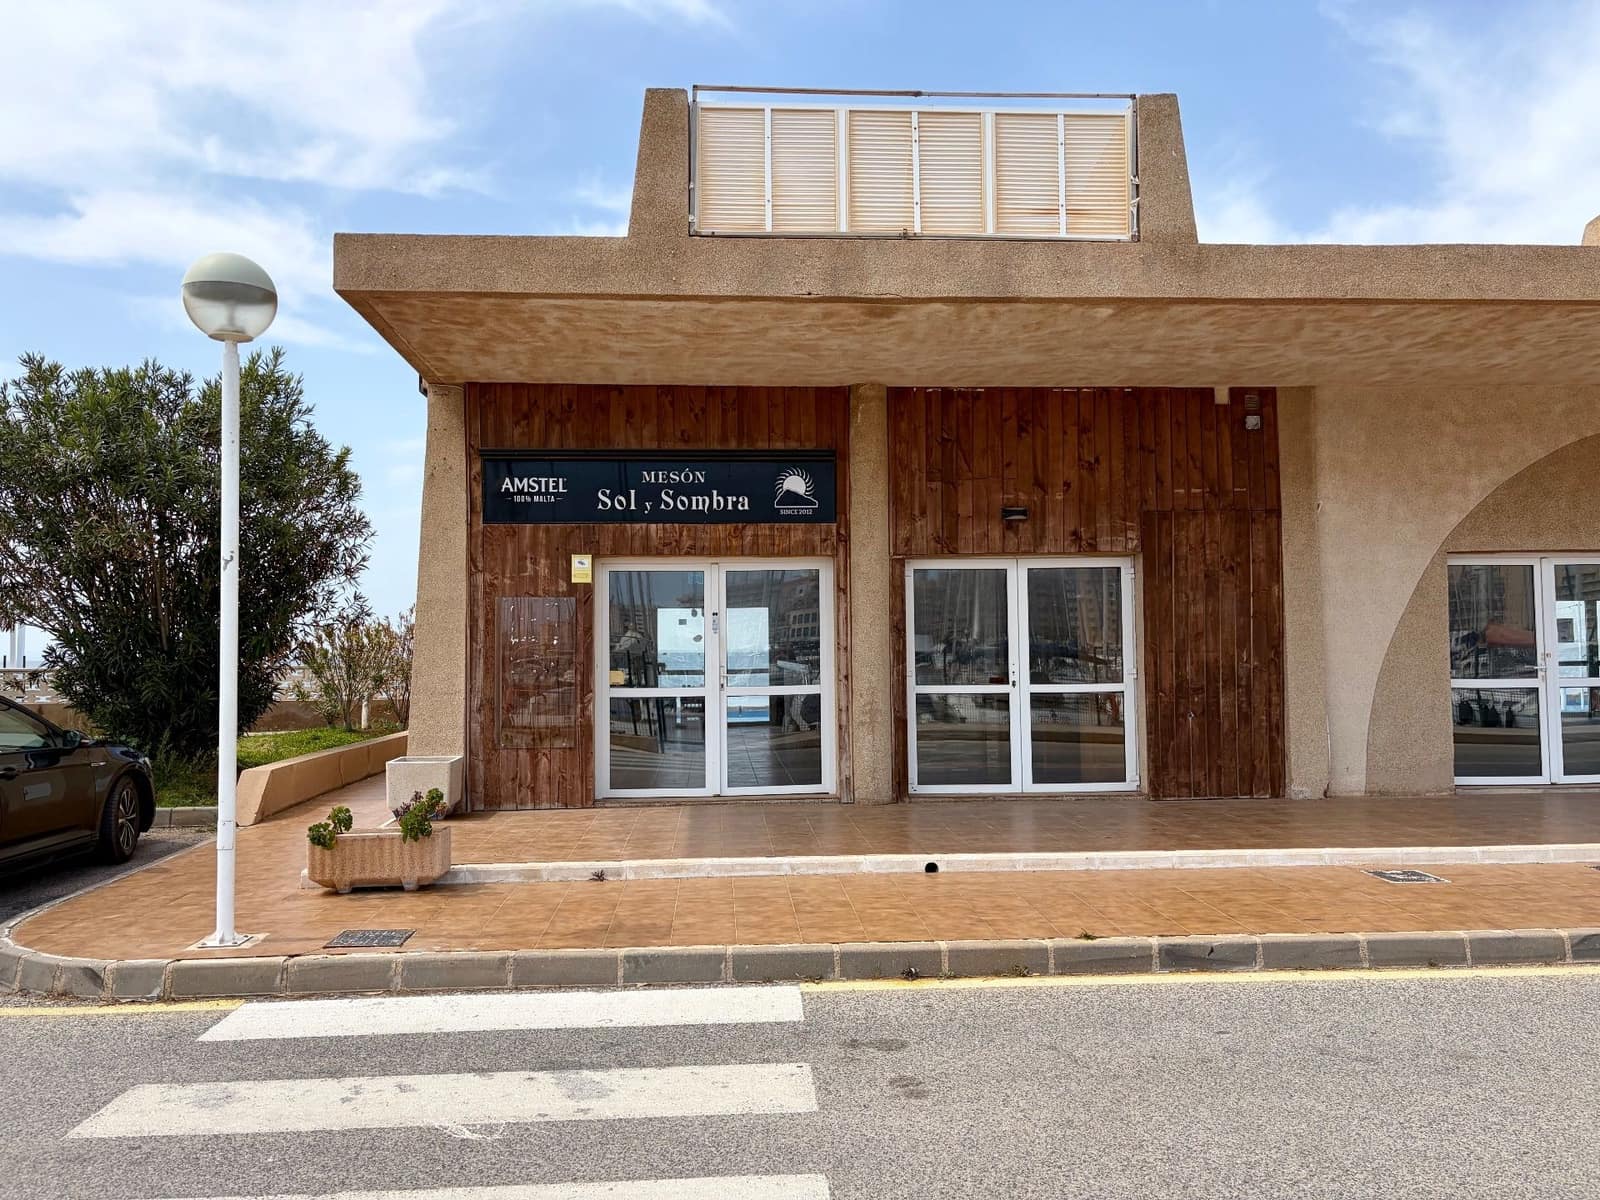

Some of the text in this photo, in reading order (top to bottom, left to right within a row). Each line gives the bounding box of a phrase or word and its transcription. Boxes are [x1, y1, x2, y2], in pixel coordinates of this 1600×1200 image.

[641, 467, 706, 484] MESÓN
[501, 477, 568, 493] AMSTEL
[513, 495, 556, 503] 100% MALTA
[597, 488, 750, 514] Sol y Sombra
